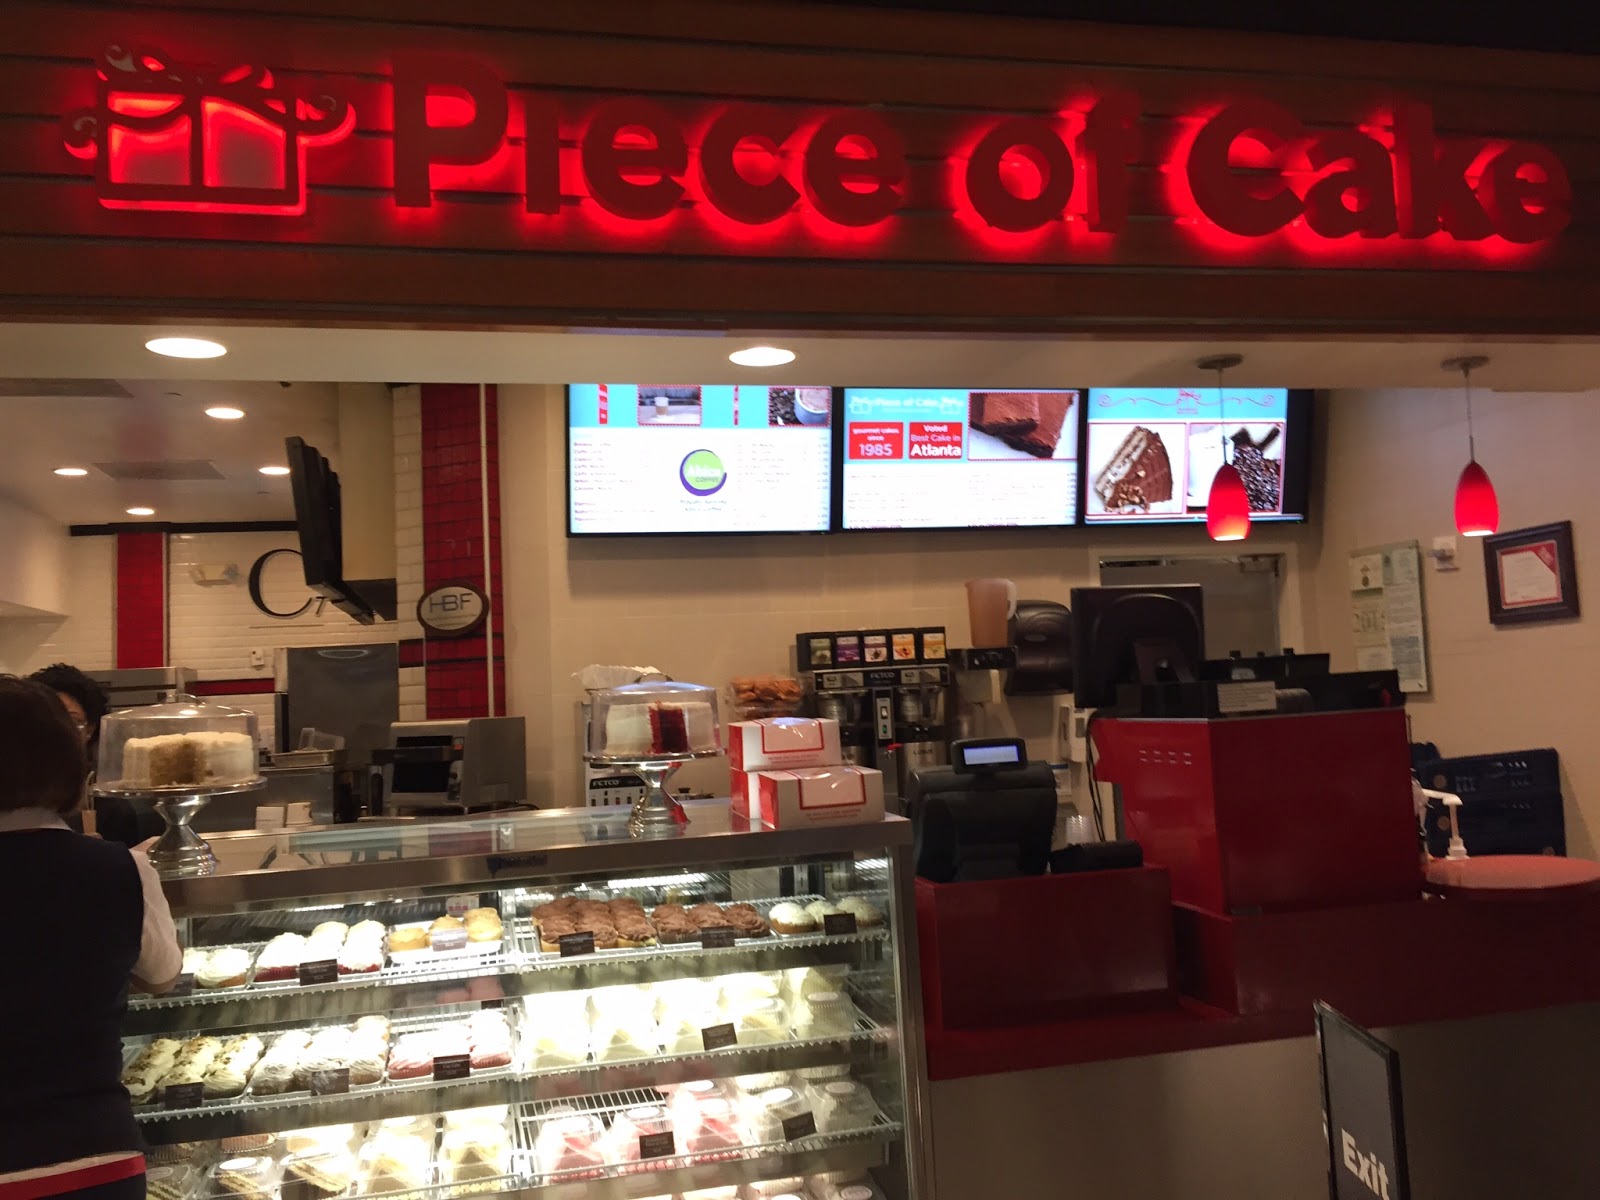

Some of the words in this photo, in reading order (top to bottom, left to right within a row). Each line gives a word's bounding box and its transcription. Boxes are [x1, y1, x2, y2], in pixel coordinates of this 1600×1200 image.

[392, 53, 905, 227] Piece
[966, 90, 1140, 234] of
[1187, 98, 1573, 244] Cake
[922, 425, 948, 433] Voted
[911, 434, 929, 442] Best
[930, 434, 952, 442] Cake
[953, 434, 961, 442] in
[859, 444, 894, 457] 1985
[910, 444, 962, 457] Atlanta
[429, 592, 473, 613] HBF
[1341, 1128, 1390, 1200] Exit
